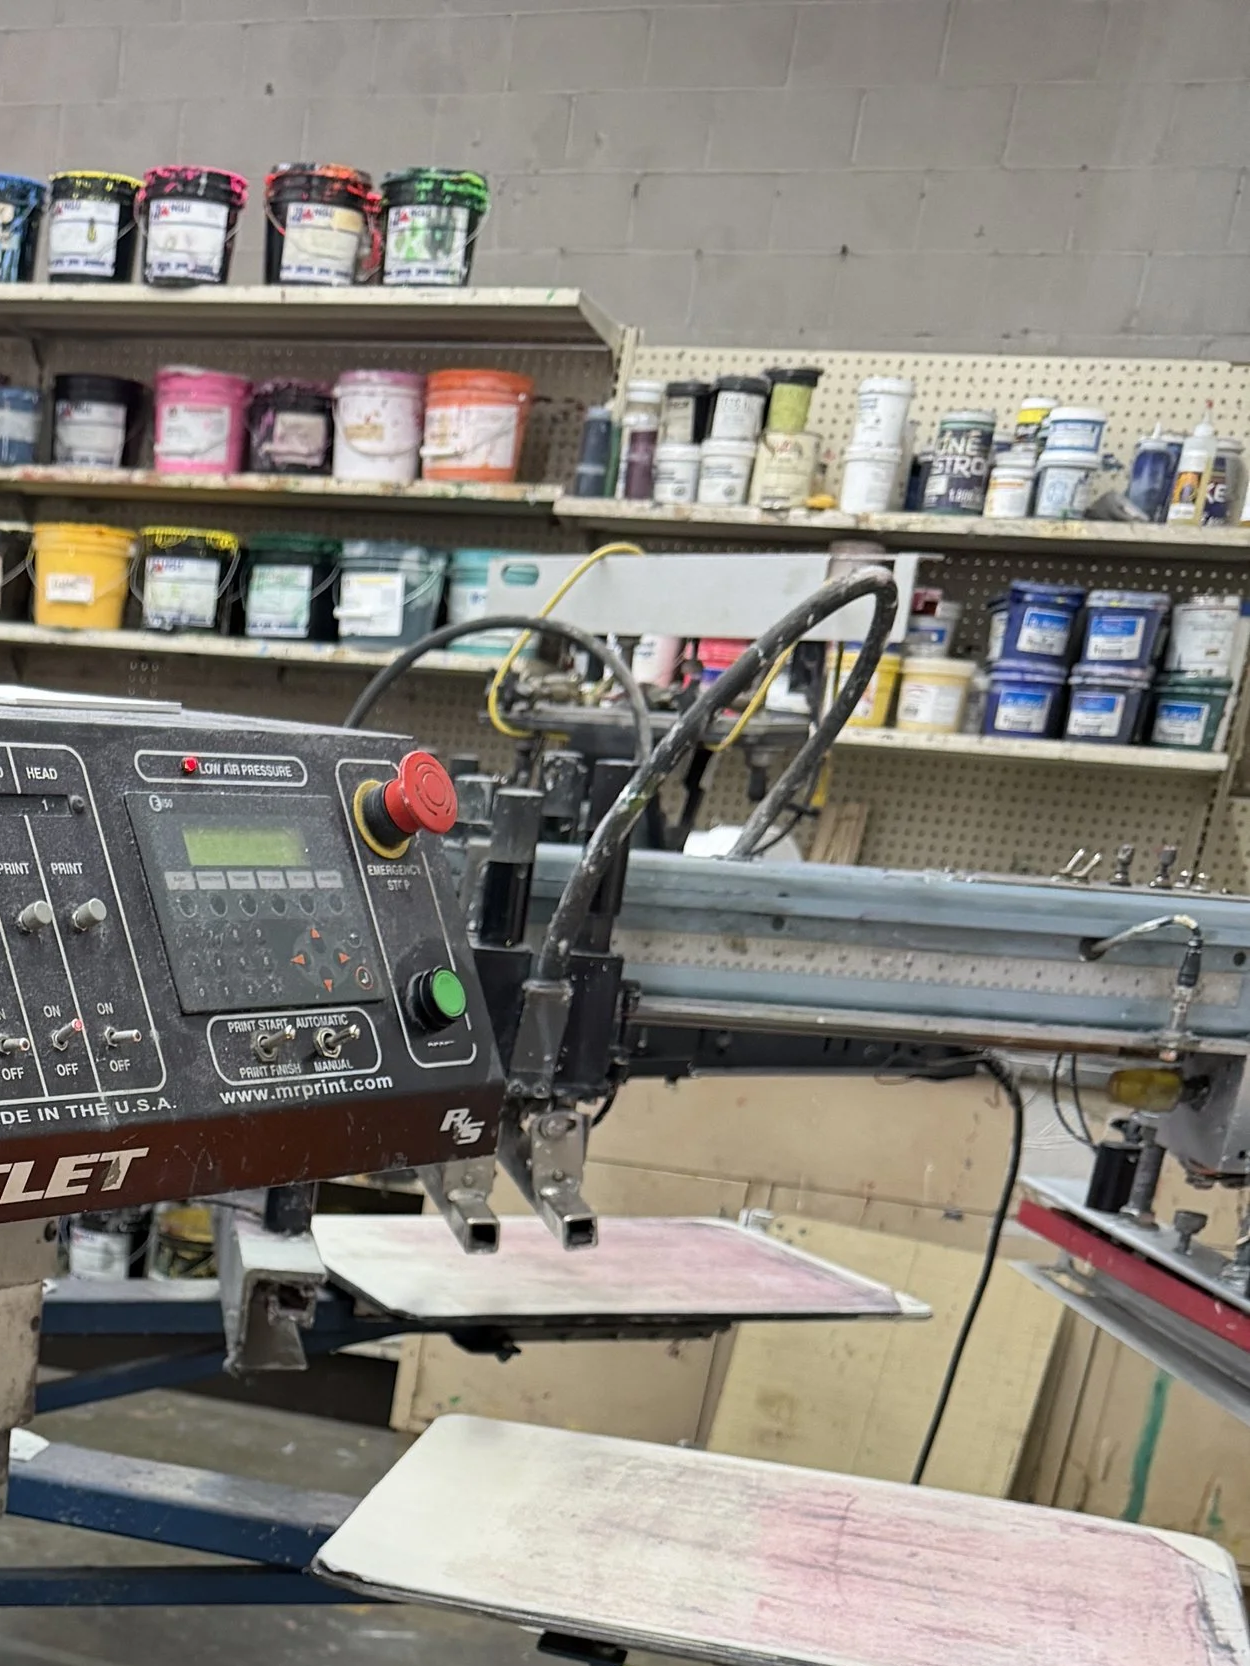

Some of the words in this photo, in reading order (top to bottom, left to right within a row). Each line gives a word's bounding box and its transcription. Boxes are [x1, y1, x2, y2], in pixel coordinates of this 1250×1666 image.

[26, 767, 58, 780] HEAD
[224, 763, 240, 775] AIR
[241, 765, 292, 777] PRESSURE
[43, 800, 48, 811] 1
[51, 863, 83, 875] PRINT
[43, 1005, 61, 1018] ON
[97, 1003, 113, 1014] ON
[228, 1021, 256, 1032] PRINT
[258, 1018, 289, 1031] START
[296, 1015, 349, 1028] AUTOMATIC
[1, 1067, 24, 1080] OFF
[57, 1063, 79, 1076] OFF
[109, 1059, 130, 1071] OFF
[239, 1067, 268, 1078] PRINT
[270, 1063, 301, 1076] FINISH
[314, 1060, 354, 1072] MANUAL
[220, 1074, 393, 1104] www.mrprint.com
[38, 1106, 60, 1122] IN
[65, 1101, 109, 1120] THE
[116, 1098, 177, 1115] U.S.A.
